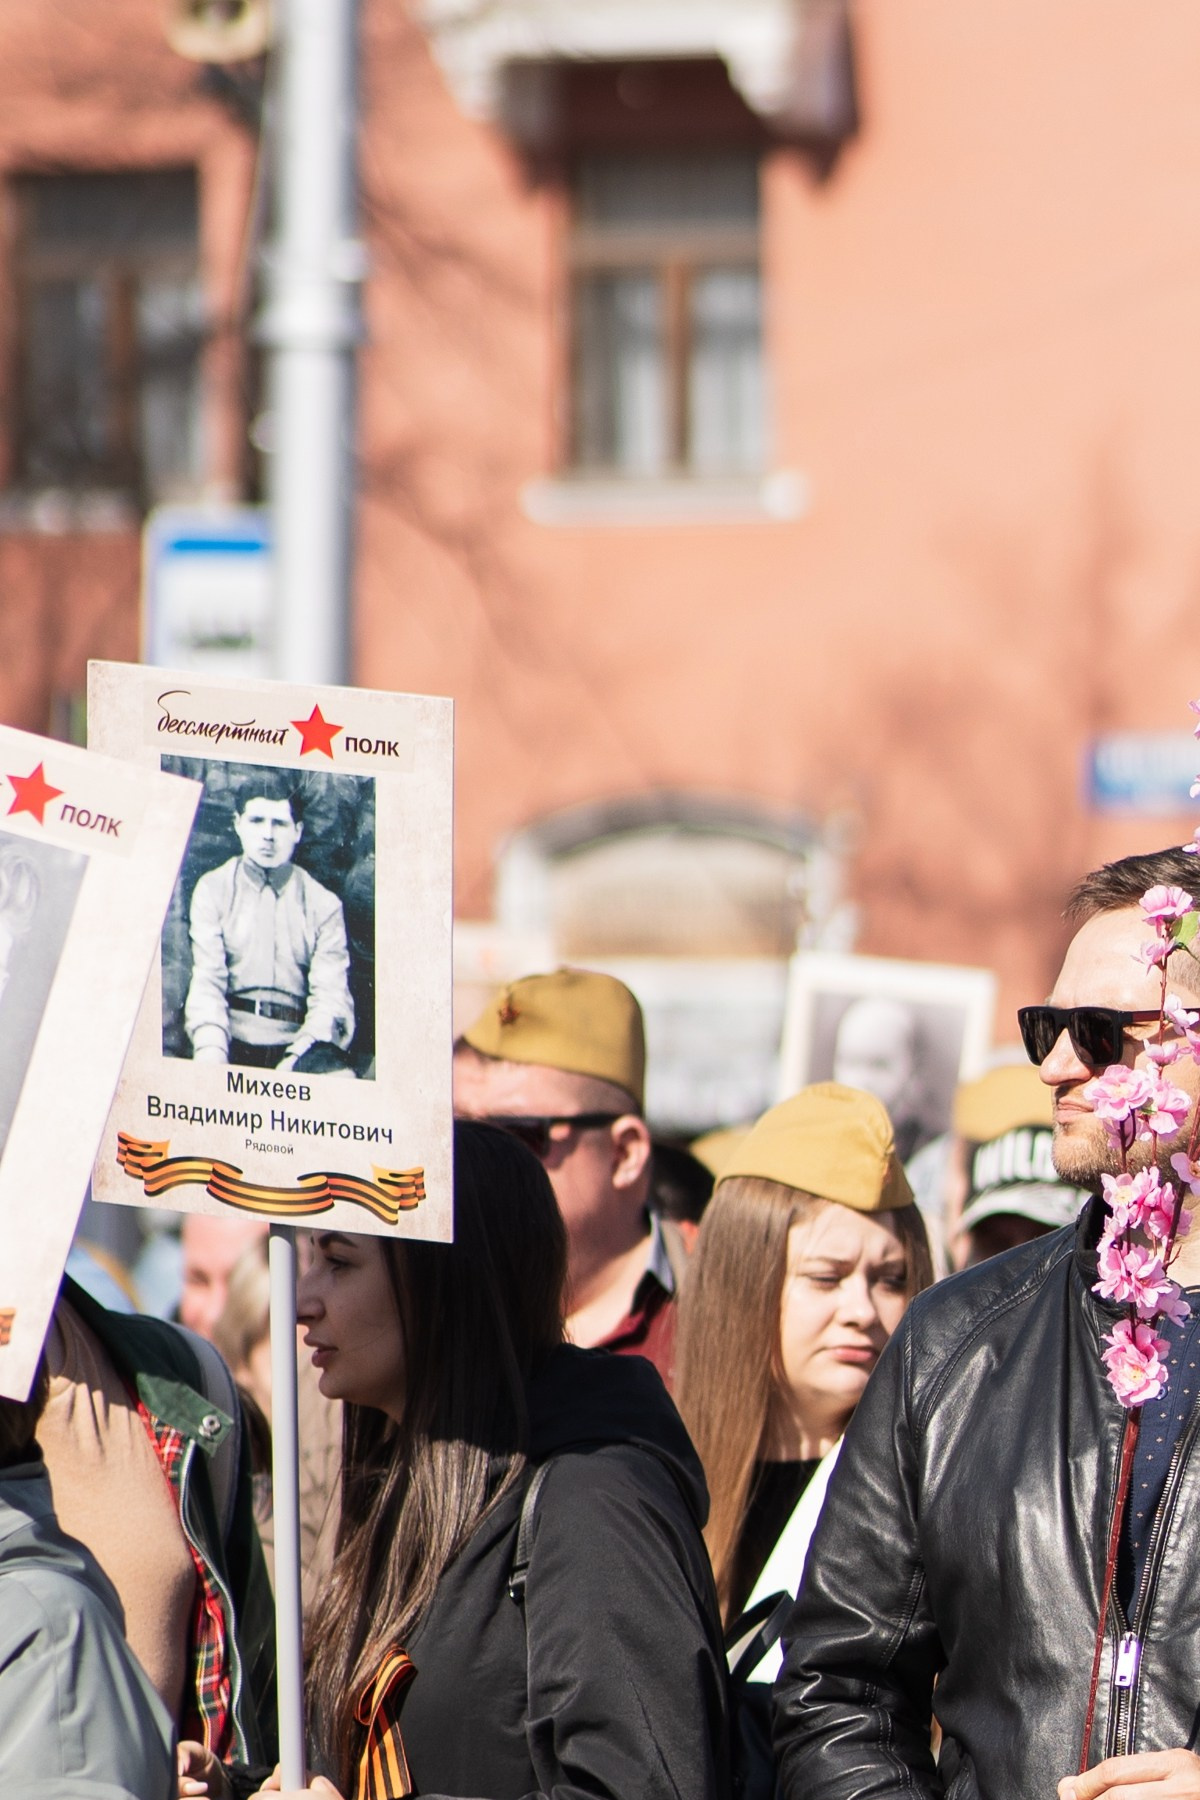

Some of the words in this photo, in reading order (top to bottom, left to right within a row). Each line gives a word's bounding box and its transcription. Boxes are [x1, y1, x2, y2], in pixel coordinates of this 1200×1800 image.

[227, 1071, 312, 1101] Михеев
[147, 1095, 263, 1134] Владимир
[270, 1109, 393, 1144] Никитович
[245, 1139, 294, 1155] Рядовой
